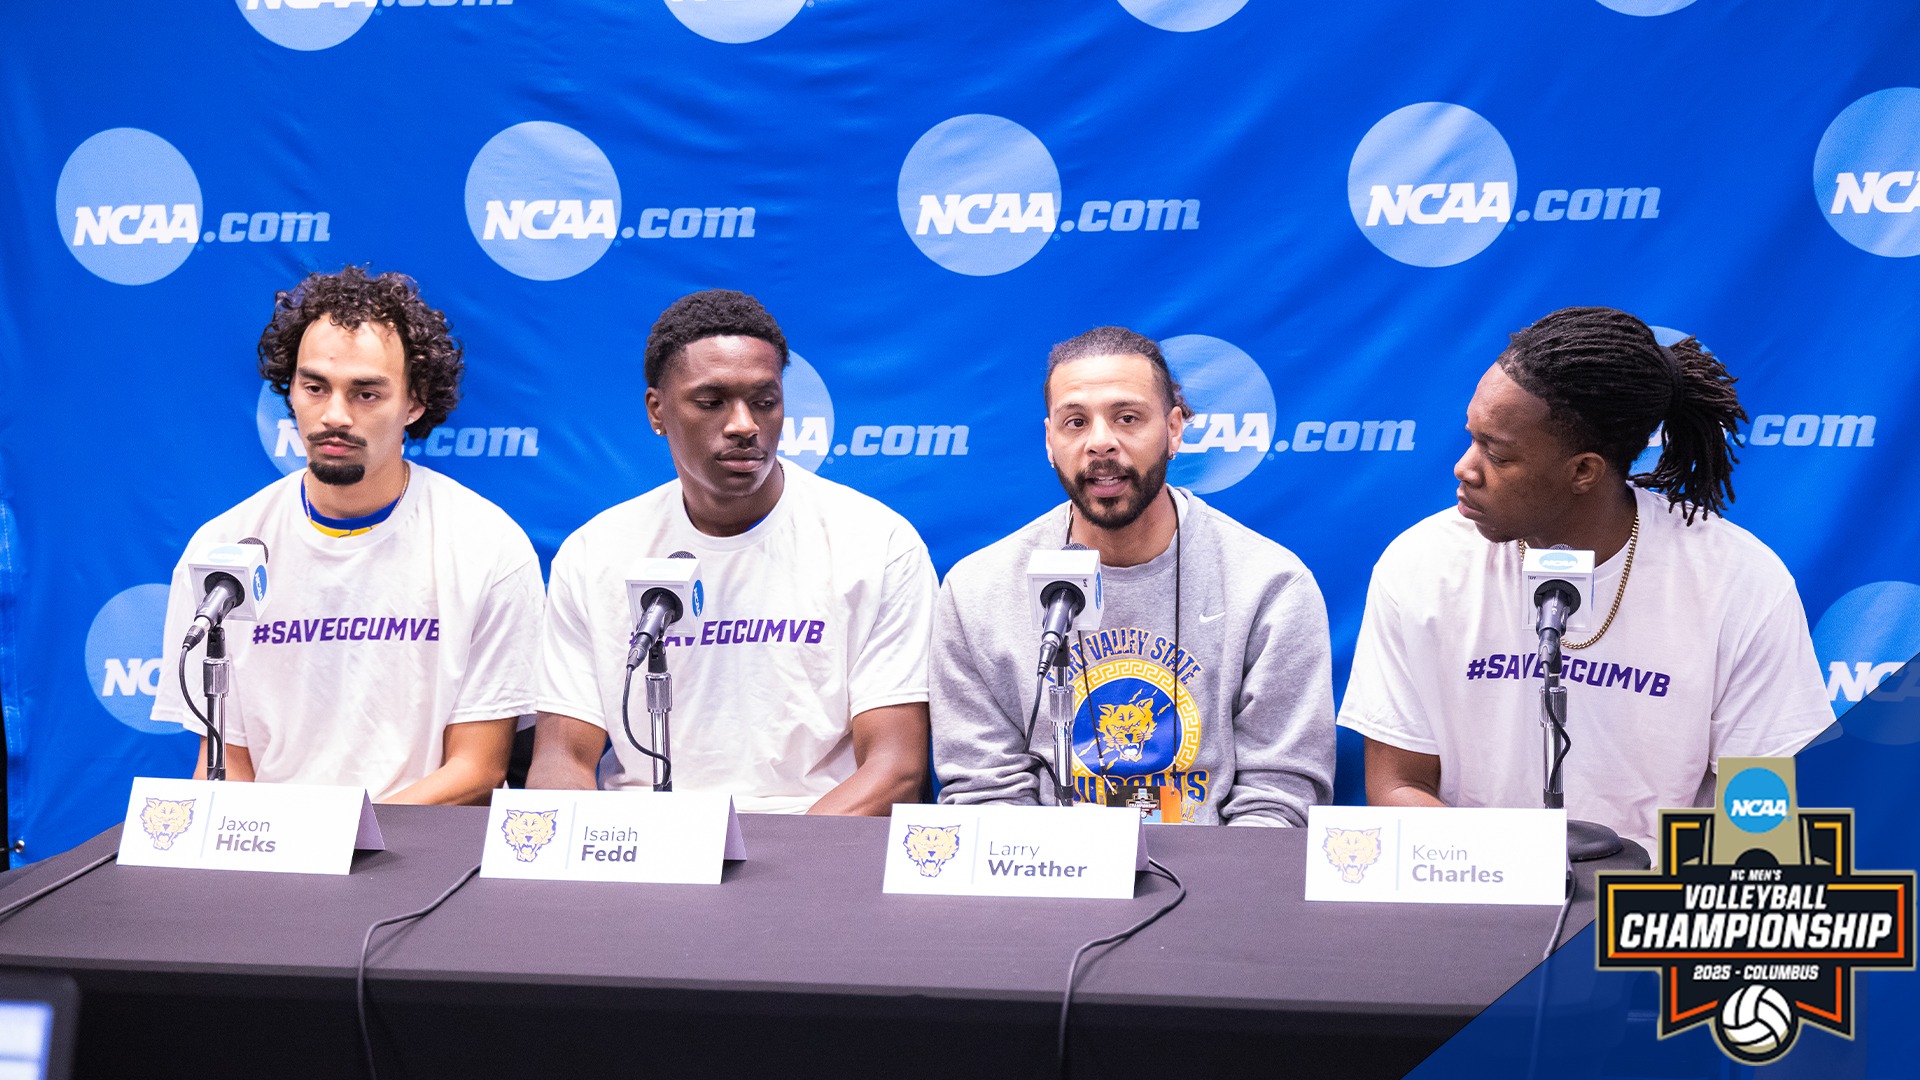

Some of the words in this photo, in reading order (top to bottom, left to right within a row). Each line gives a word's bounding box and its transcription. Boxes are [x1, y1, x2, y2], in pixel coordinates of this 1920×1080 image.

[916, 192, 1200, 235] NCAA.com
[1365, 182, 1661, 226] NCAA.com
[73, 204, 330, 246] NCAA.com
[482, 199, 756, 240] NCAA.com
[1176, 413, 1416, 453] CAA.com
[253, 617, 439, 645] #SAVEGCUMVB
[1085, 628, 1151, 661] VALLEY
[1150, 636, 1203, 686] STATE
[217, 815, 271, 832] Jaxon
[583, 825, 638, 842] Isaiah
[215, 833, 276, 853] Hicks
[989, 840, 1040, 860] Larry
[1412, 844, 1468, 861] Kevin
[581, 844, 638, 863] Fedd
[987, 859, 1088, 878] Wrather
[1411, 863, 1504, 883] Charles
